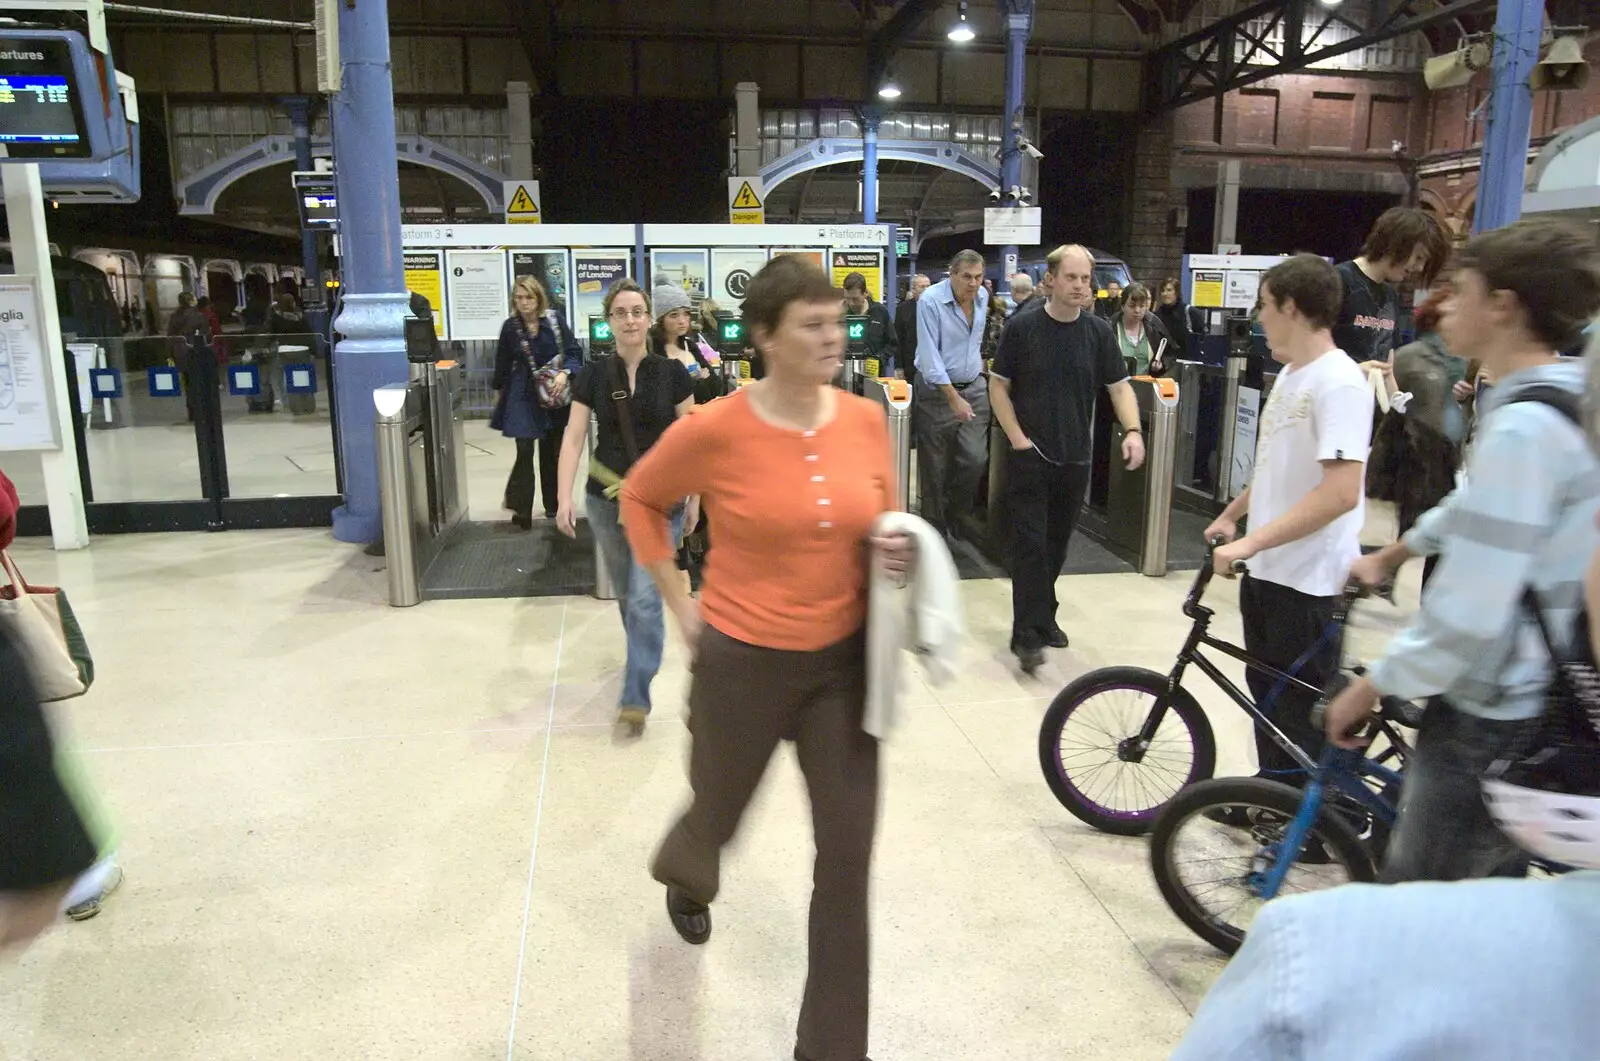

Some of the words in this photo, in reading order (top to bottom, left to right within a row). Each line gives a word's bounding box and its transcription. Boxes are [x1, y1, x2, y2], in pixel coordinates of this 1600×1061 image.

[0, 50, 44, 60] artures
[403, 228, 432, 239] atform
[434, 228, 441, 239] 3
[829, 228, 864, 239] Platform
[866, 228, 873, 239] 2
[404, 256, 436, 264] WARNING
[600, 264, 623, 273] magic
[0, 309, 24, 323] glia
